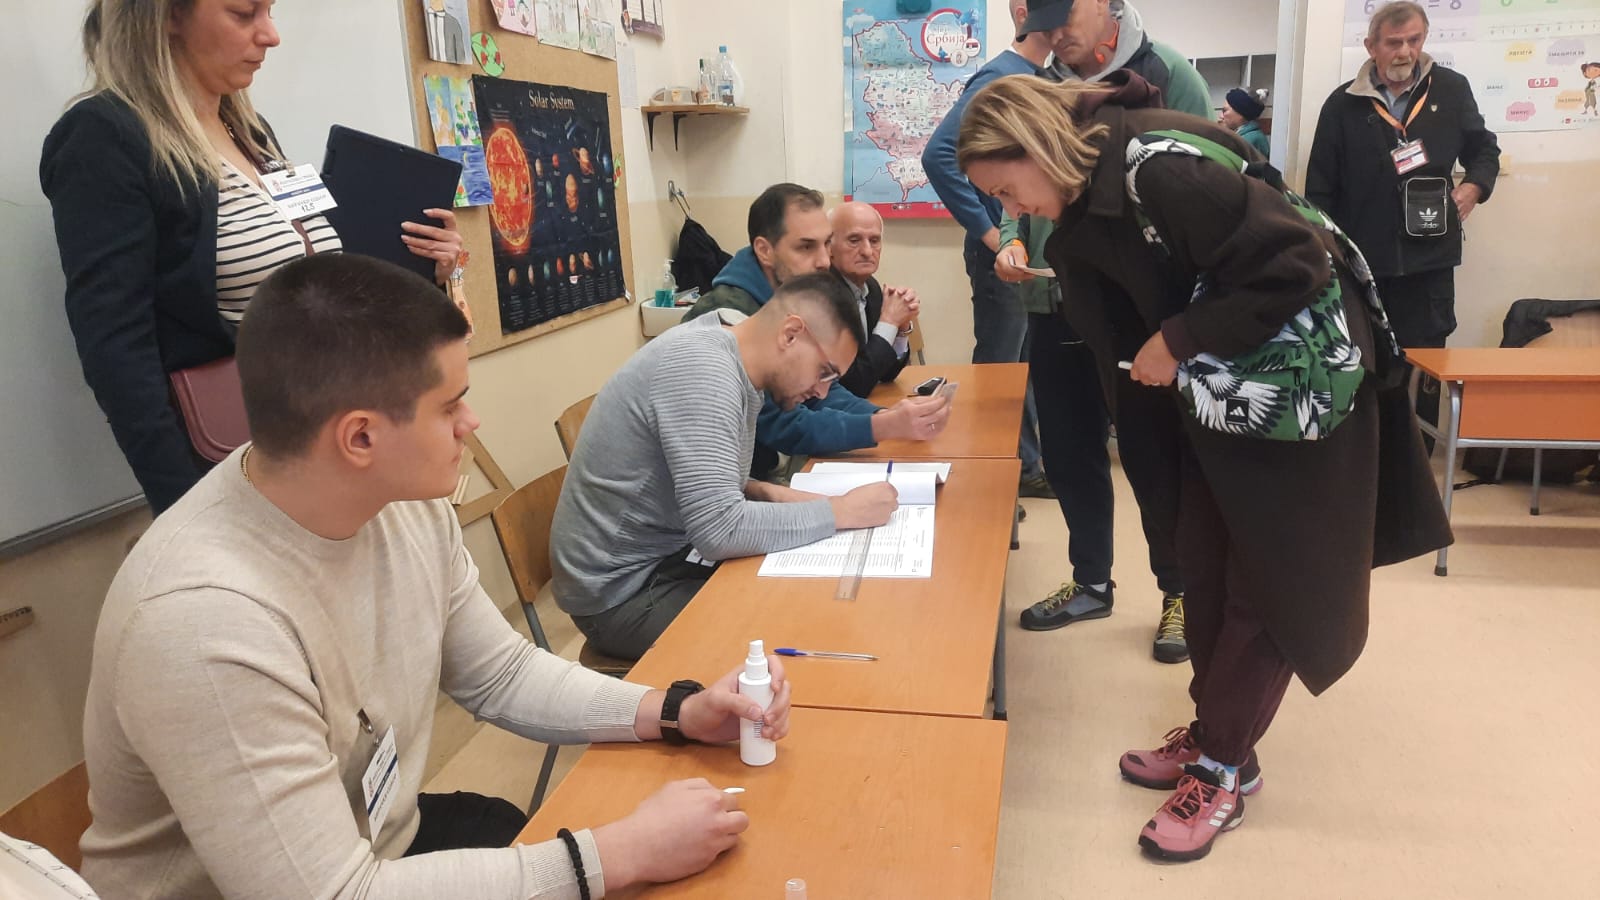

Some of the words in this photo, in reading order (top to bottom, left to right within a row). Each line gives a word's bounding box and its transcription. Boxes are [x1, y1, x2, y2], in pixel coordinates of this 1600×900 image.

[926, 32, 966, 47] Србија
[528, 89, 549, 109] Solar
[550, 92, 576, 112] System
